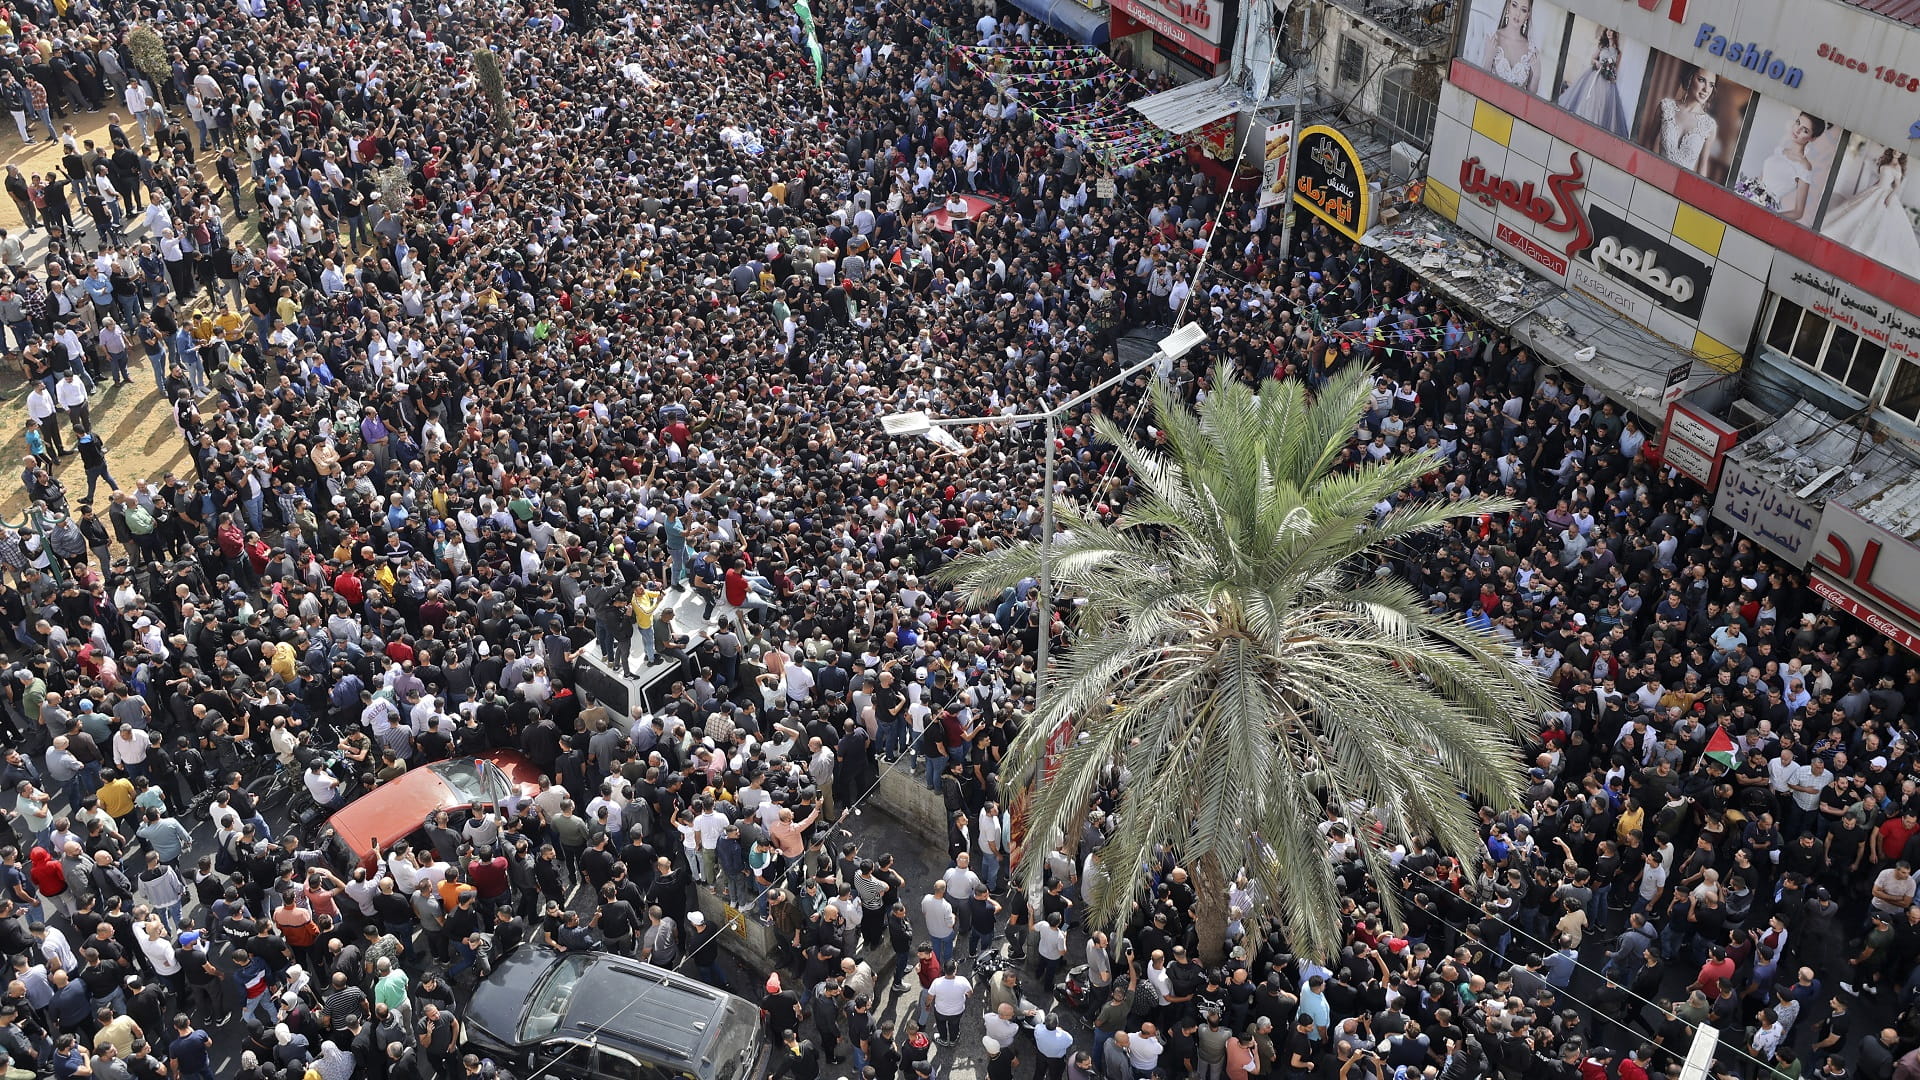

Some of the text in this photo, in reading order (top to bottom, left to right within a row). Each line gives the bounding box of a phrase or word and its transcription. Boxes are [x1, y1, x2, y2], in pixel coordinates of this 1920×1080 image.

[1163, 24, 1186, 42] للتجارة
[1693, 22, 1804, 89] Fashion
[1816, 42, 1920, 93] Since 1958
[1590, 235, 1695, 303] مطعم
[1841, 293, 1878, 318] تحسين
[1878, 312, 1902, 330] نزار
[1861, 326, 1889, 343] القلب
